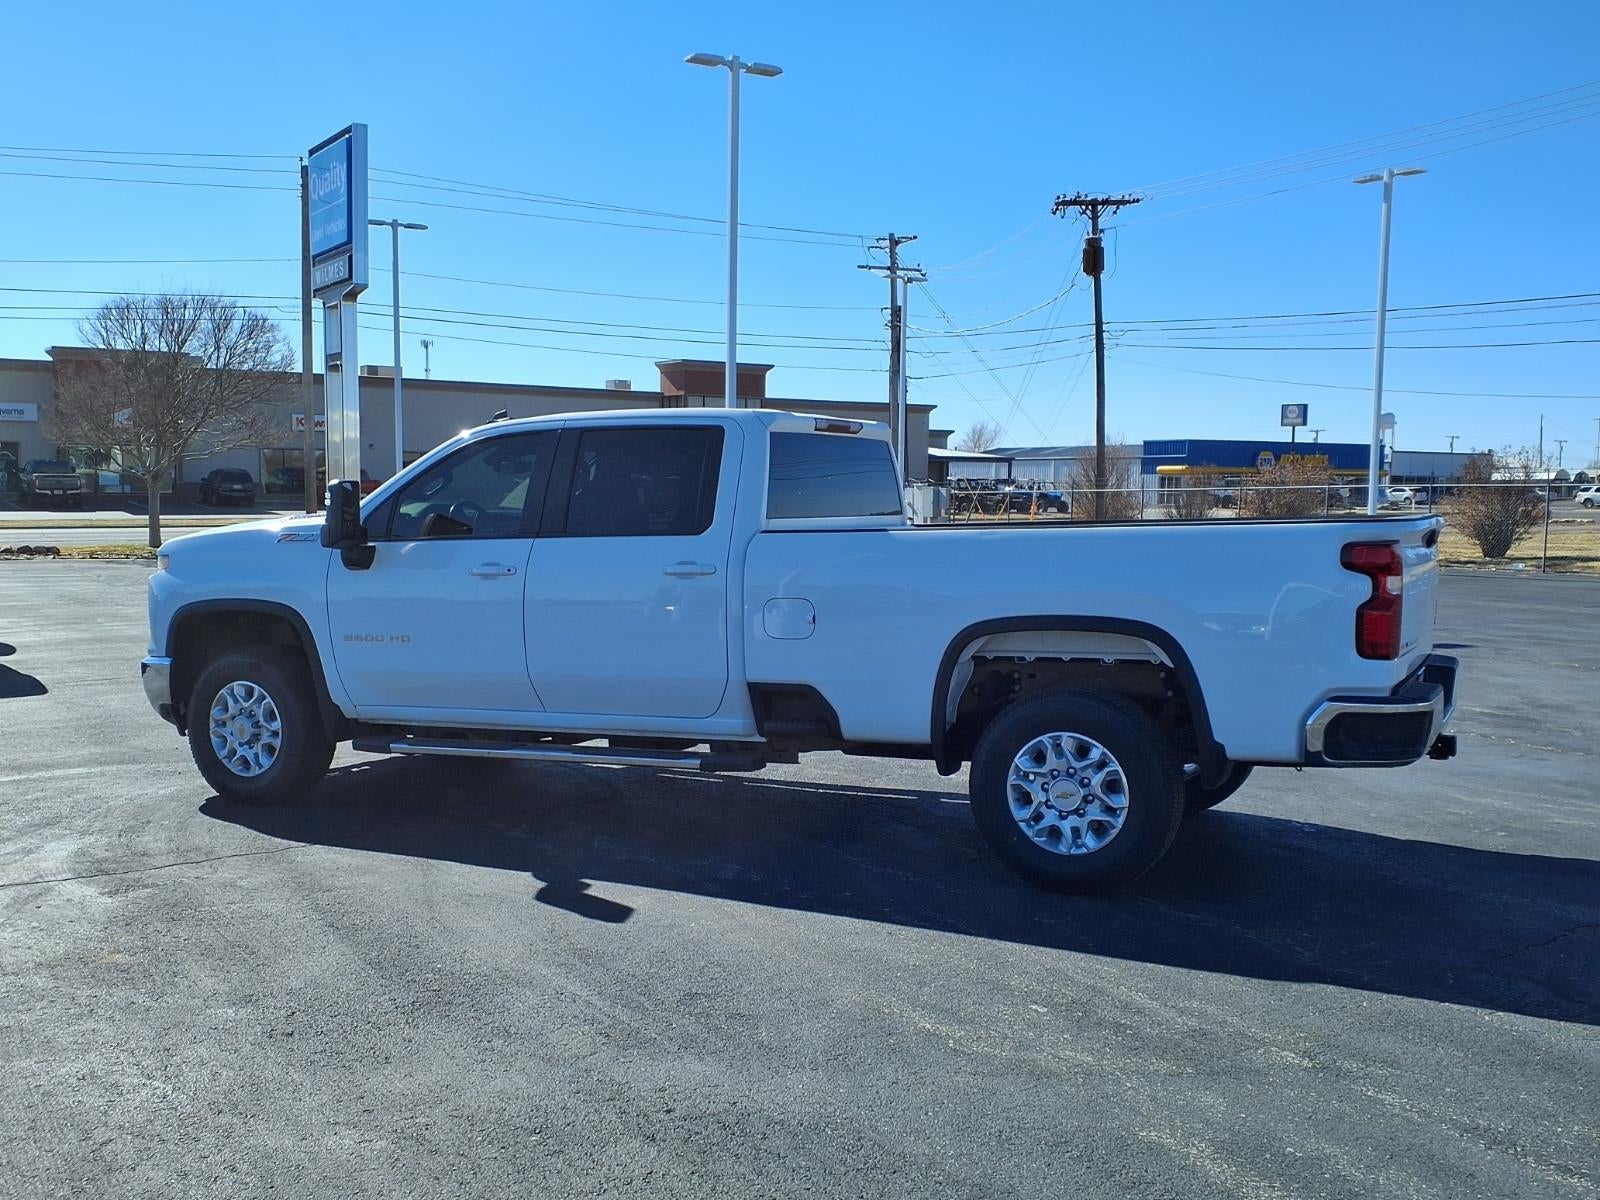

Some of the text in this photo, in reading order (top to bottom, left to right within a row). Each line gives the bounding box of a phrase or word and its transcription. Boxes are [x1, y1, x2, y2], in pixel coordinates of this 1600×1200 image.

[311, 161, 346, 200] Quality
[315, 262, 344, 284] WILMES
[390, 634, 411, 643] HD
